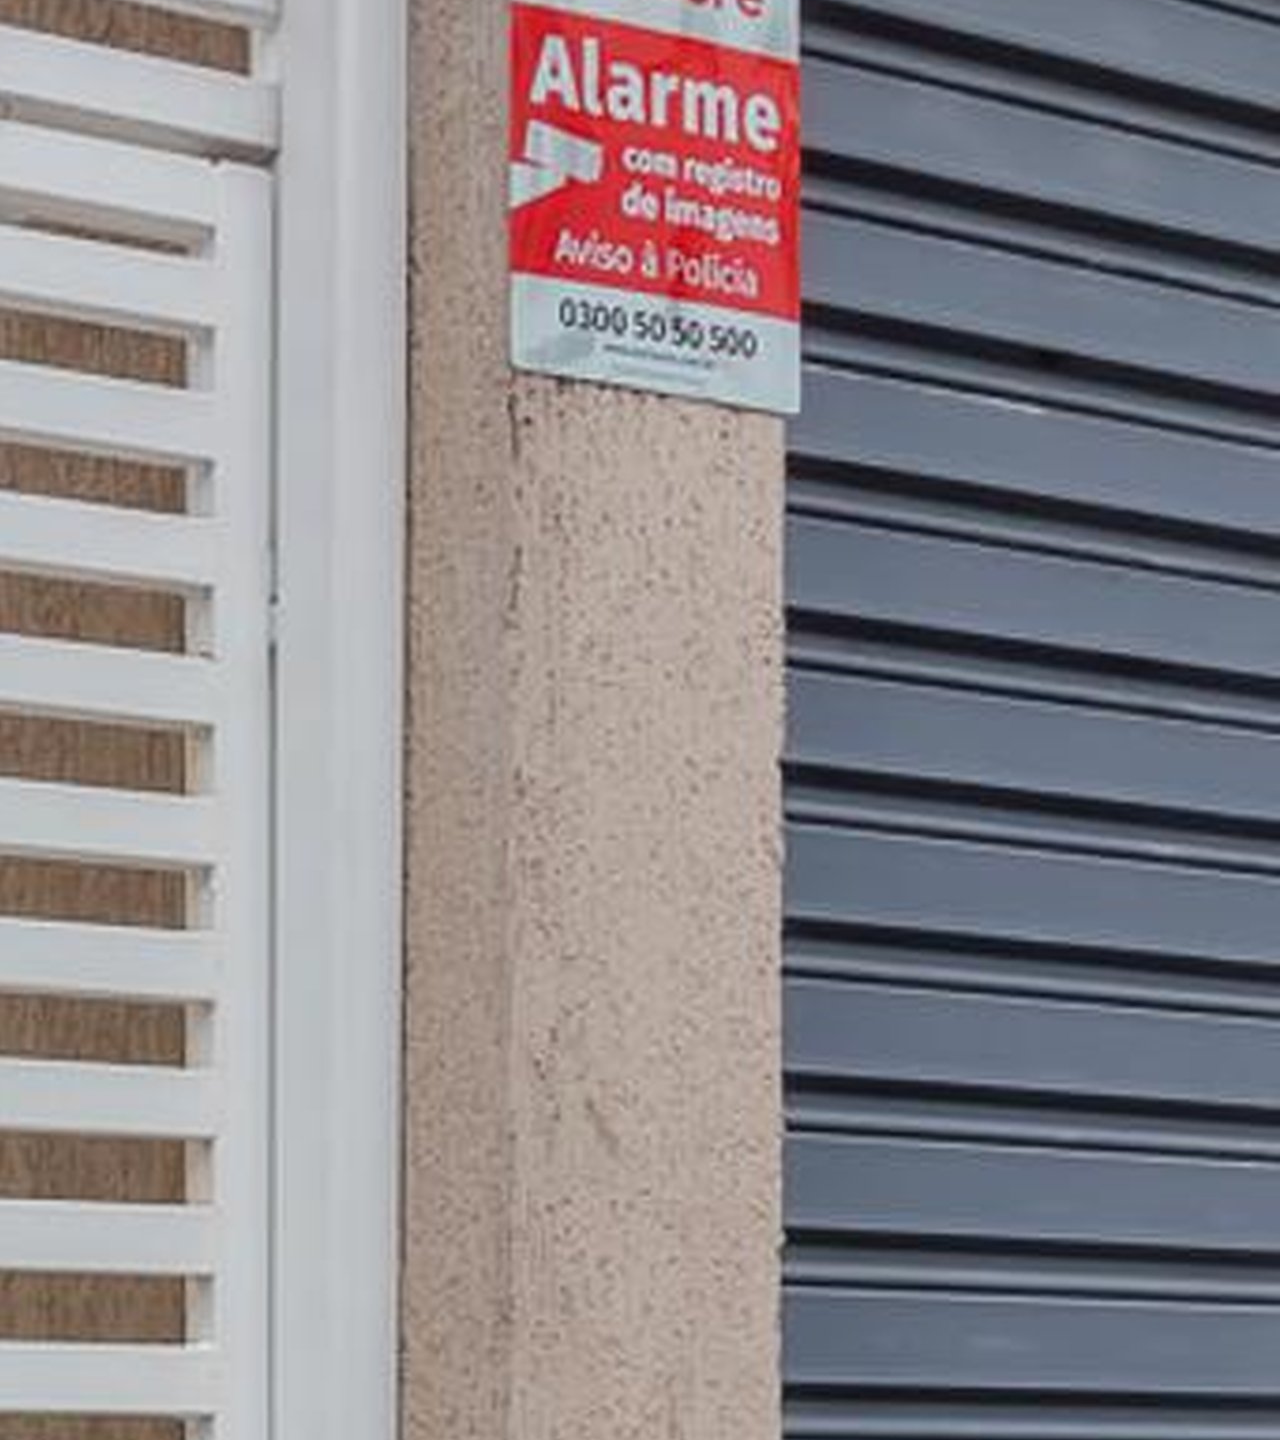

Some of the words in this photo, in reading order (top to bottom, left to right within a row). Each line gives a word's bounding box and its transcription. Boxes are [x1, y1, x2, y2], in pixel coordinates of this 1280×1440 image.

[529, 33, 782, 152] Alarme
[621, 146, 678, 179] com
[683, 157, 781, 201] registro
[621, 182, 660, 221] de
[664, 186, 780, 245] imagens
[554, 227, 635, 274] Aviso
[559, 298, 628, 336] 0300
[632, 311, 667, 343] 50
[670, 316, 704, 350] 50
[709, 325, 758, 359] 500
